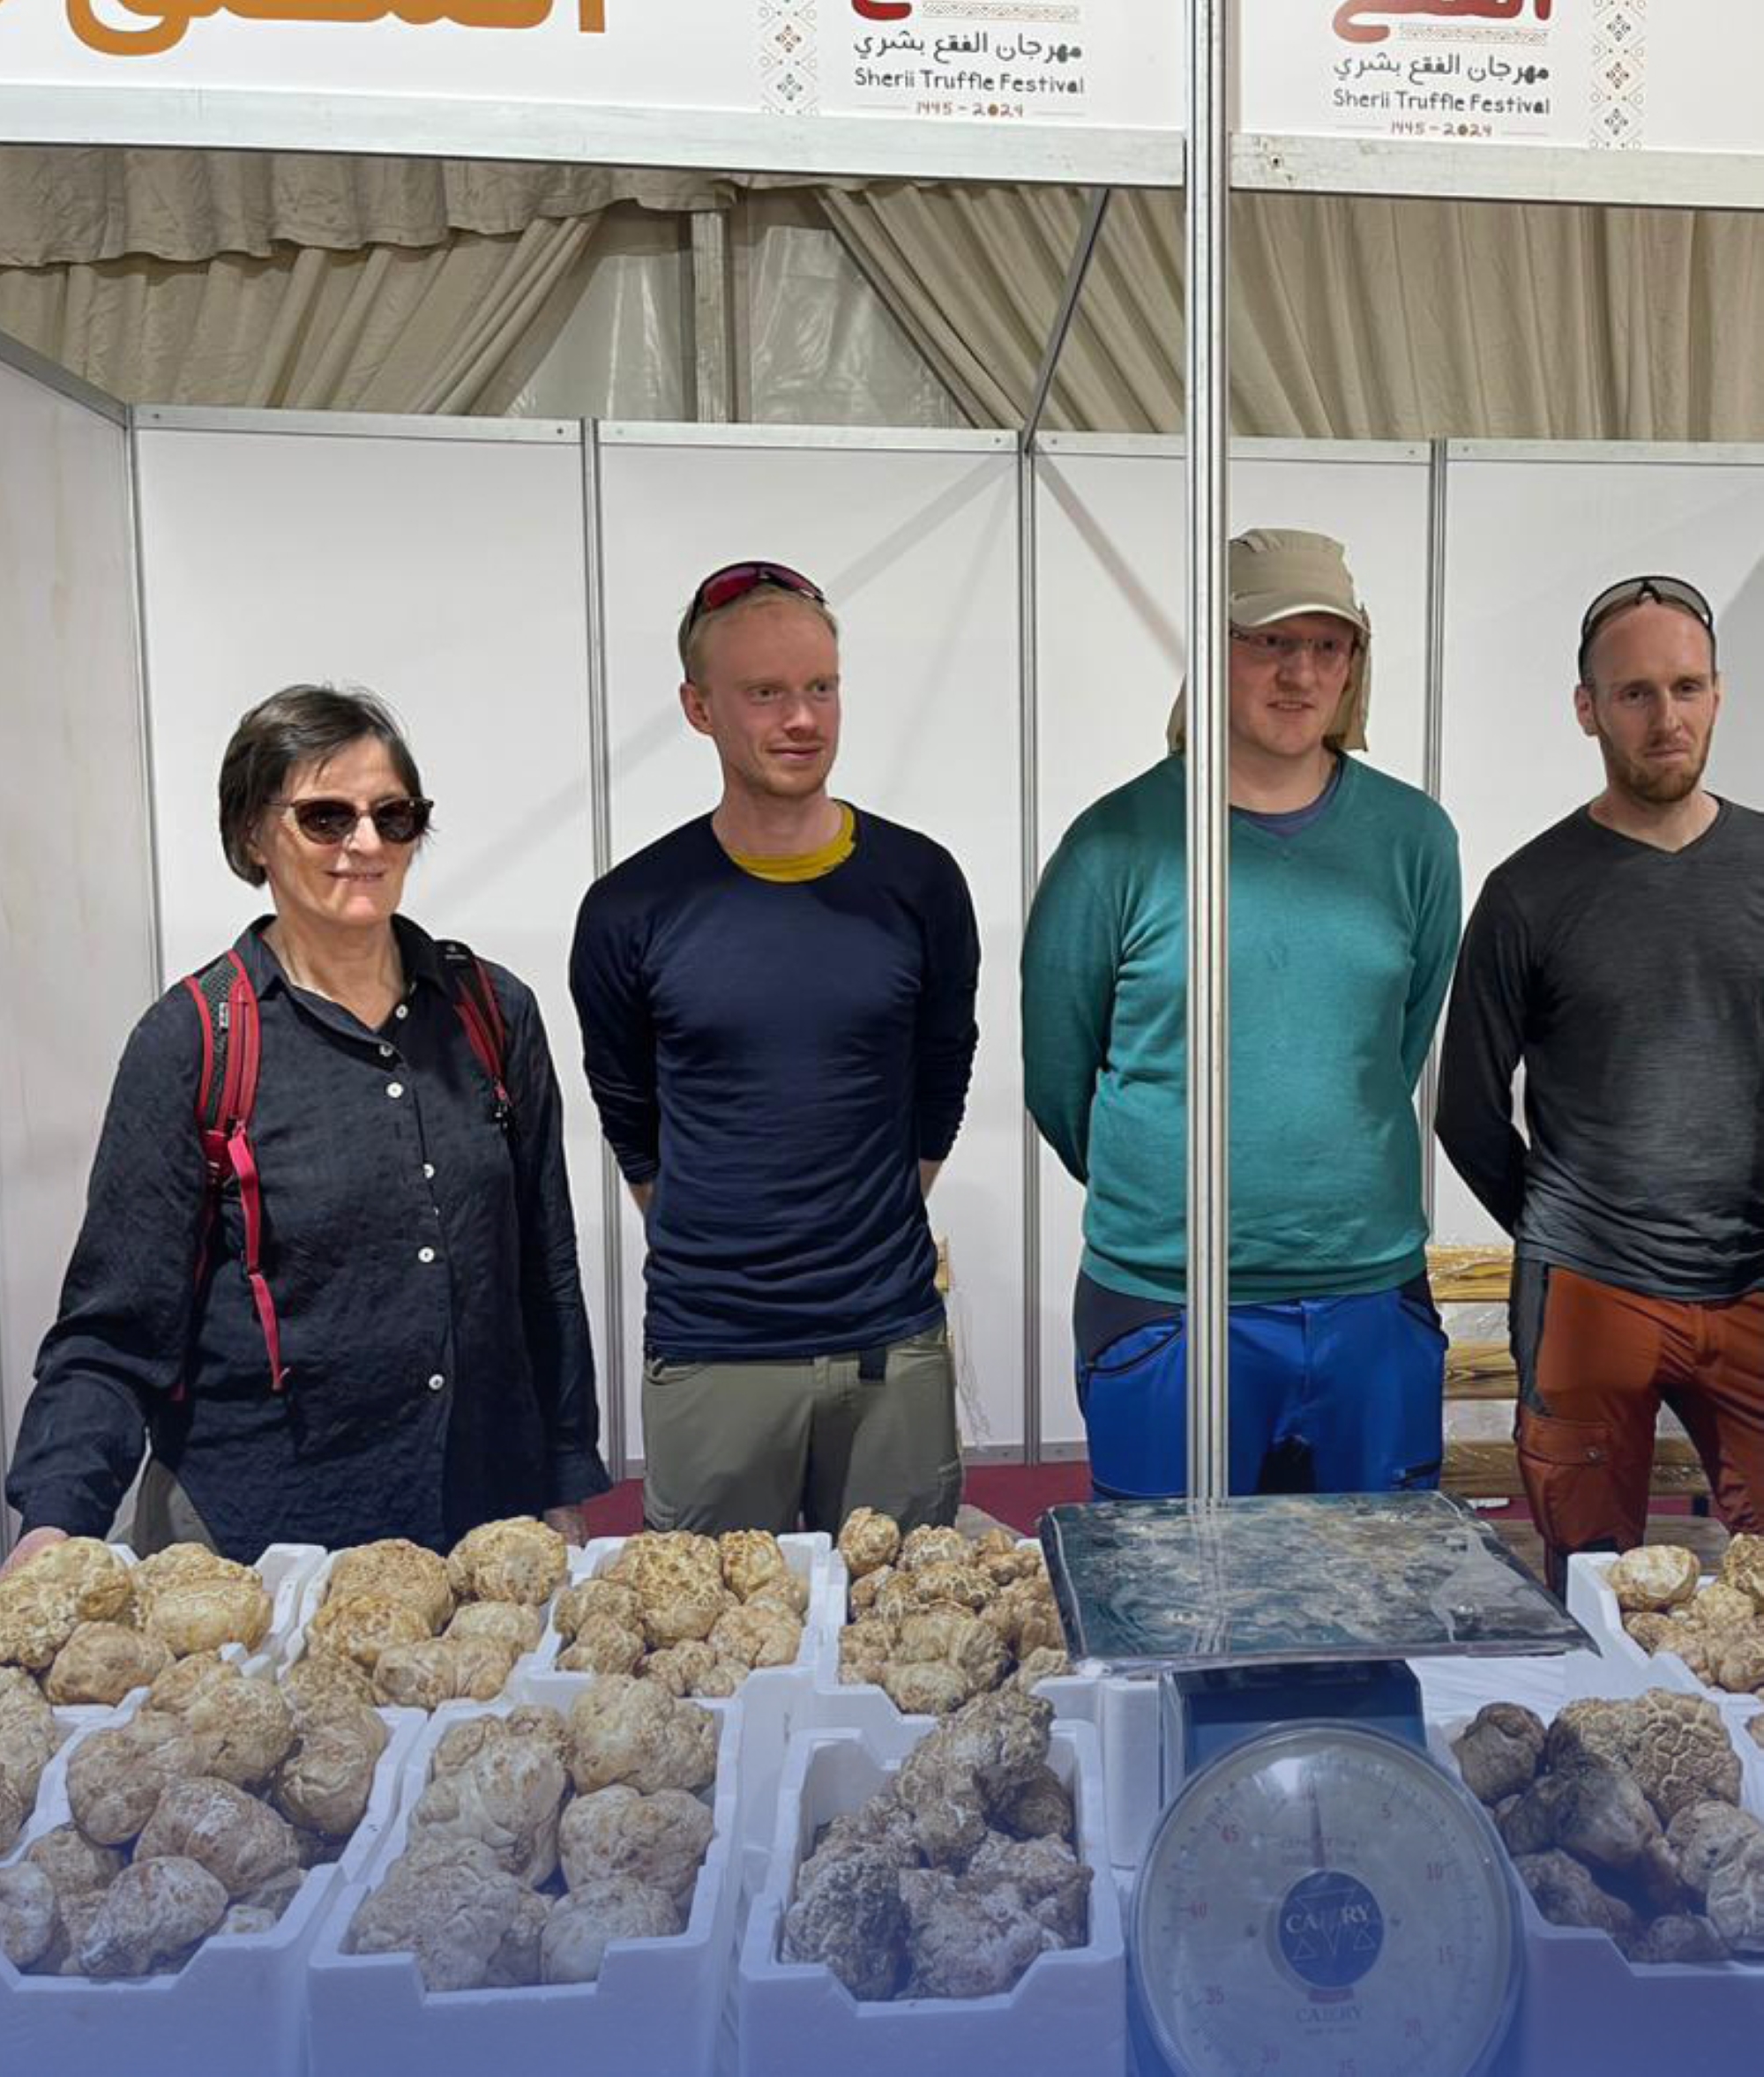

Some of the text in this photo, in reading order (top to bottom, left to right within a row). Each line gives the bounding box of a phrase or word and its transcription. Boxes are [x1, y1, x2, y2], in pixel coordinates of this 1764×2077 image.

[854, 30, 1082, 64] مهرجان الفقع بشري
[855, 68, 1085, 94] Sherii Truffle Festival
[1333, 52, 1550, 85] مهرجان الفقع بشري
[1333, 88, 1551, 115] Sherii Truffle Festival
